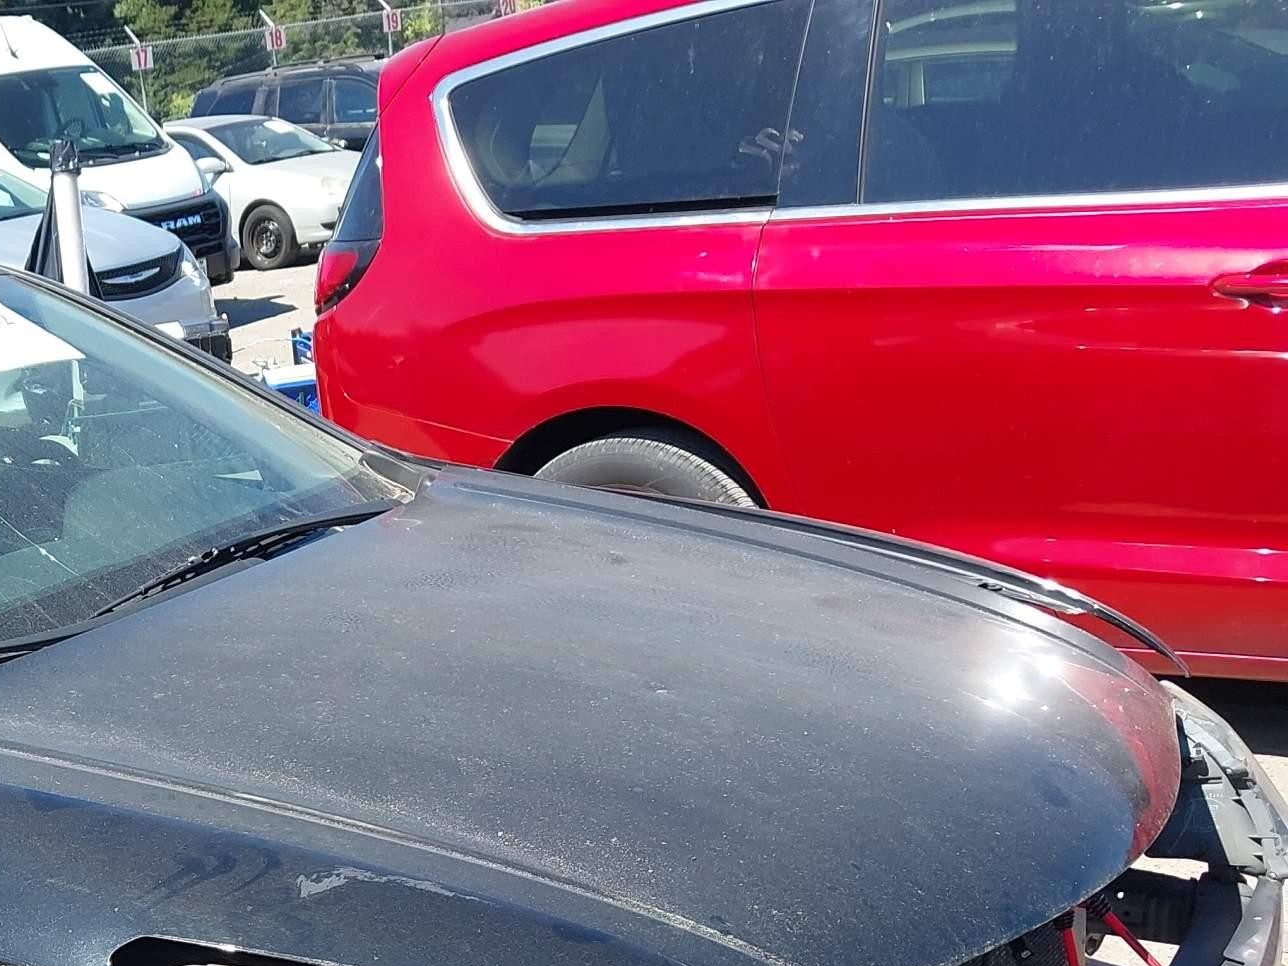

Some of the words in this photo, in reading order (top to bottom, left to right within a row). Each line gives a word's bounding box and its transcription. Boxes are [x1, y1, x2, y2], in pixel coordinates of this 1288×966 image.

[386, 12, 399, 30] 19
[268, 28, 283, 49] 18
[135, 48, 148, 68] 17
[160, 214, 202, 230] RAM
